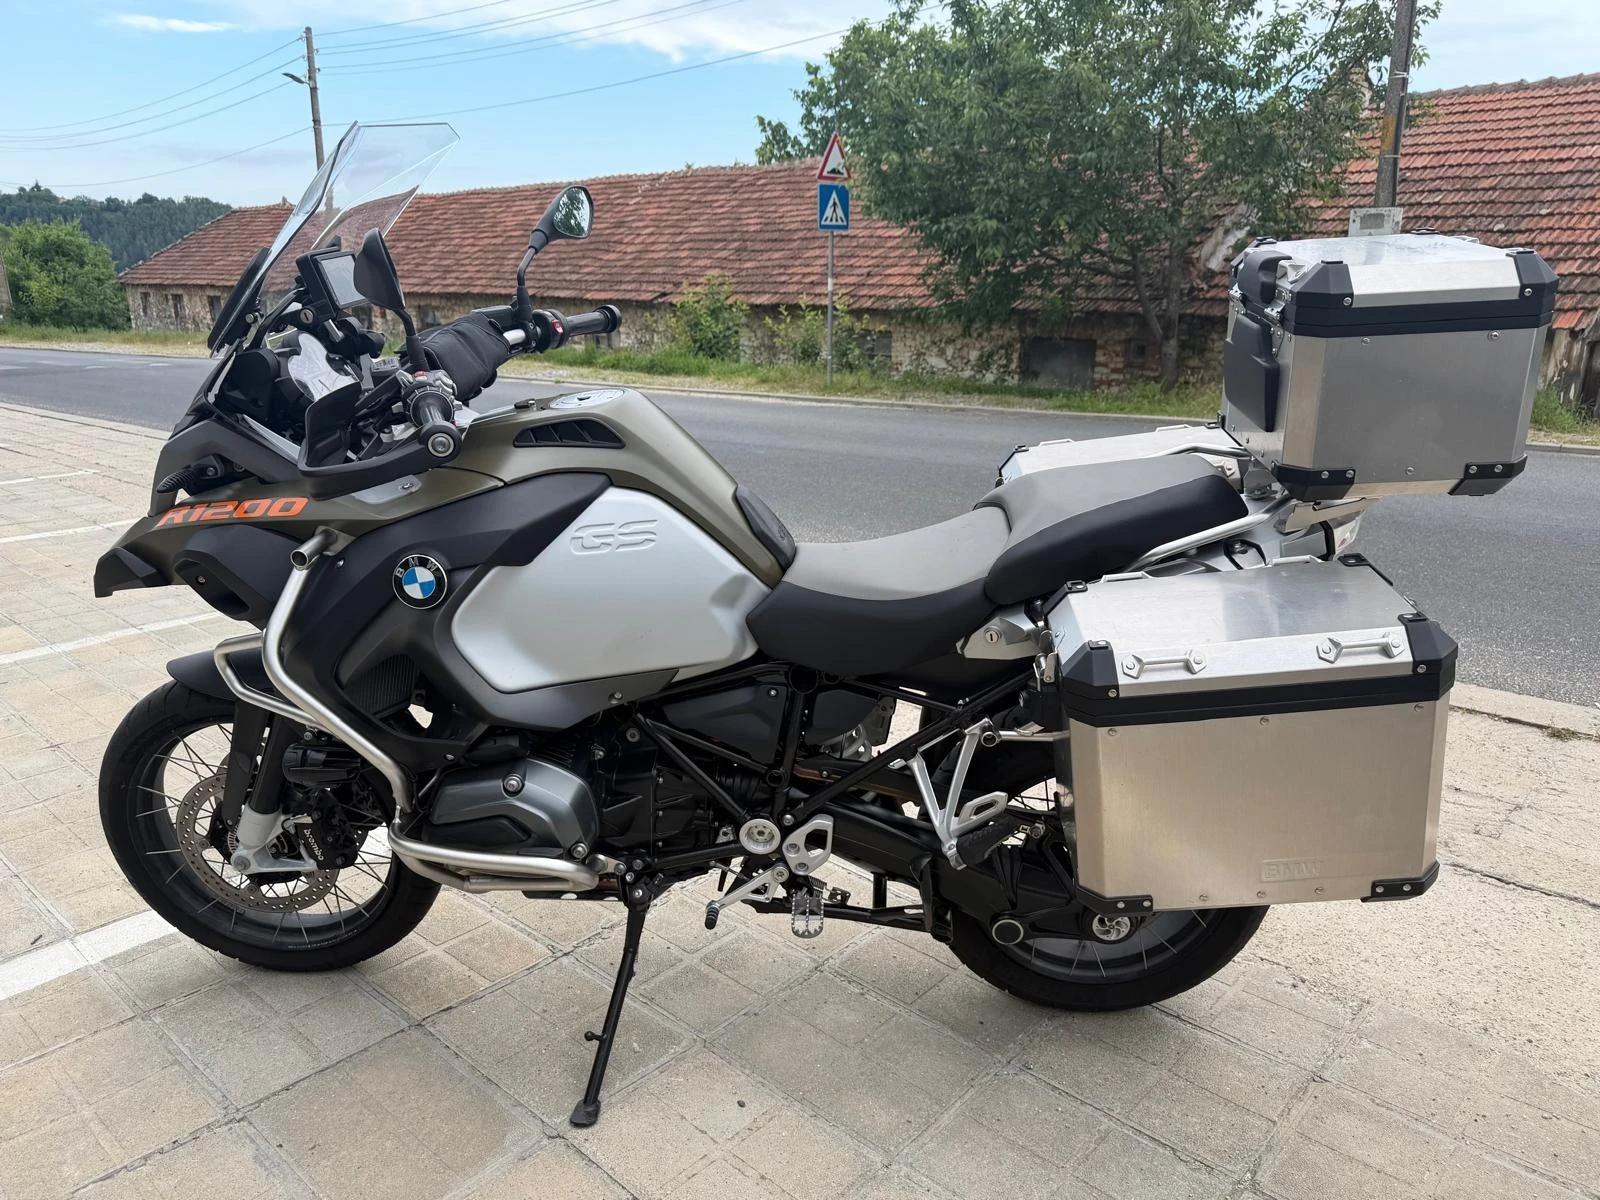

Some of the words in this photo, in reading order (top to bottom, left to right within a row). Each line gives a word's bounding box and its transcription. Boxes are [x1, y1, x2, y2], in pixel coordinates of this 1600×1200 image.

[155, 497, 309, 527] R1200
[569, 519, 658, 555] GS
[395, 556, 438, 578] BMW
[303, 828, 324, 861] brembo
[1262, 862, 1320, 879] BMW
